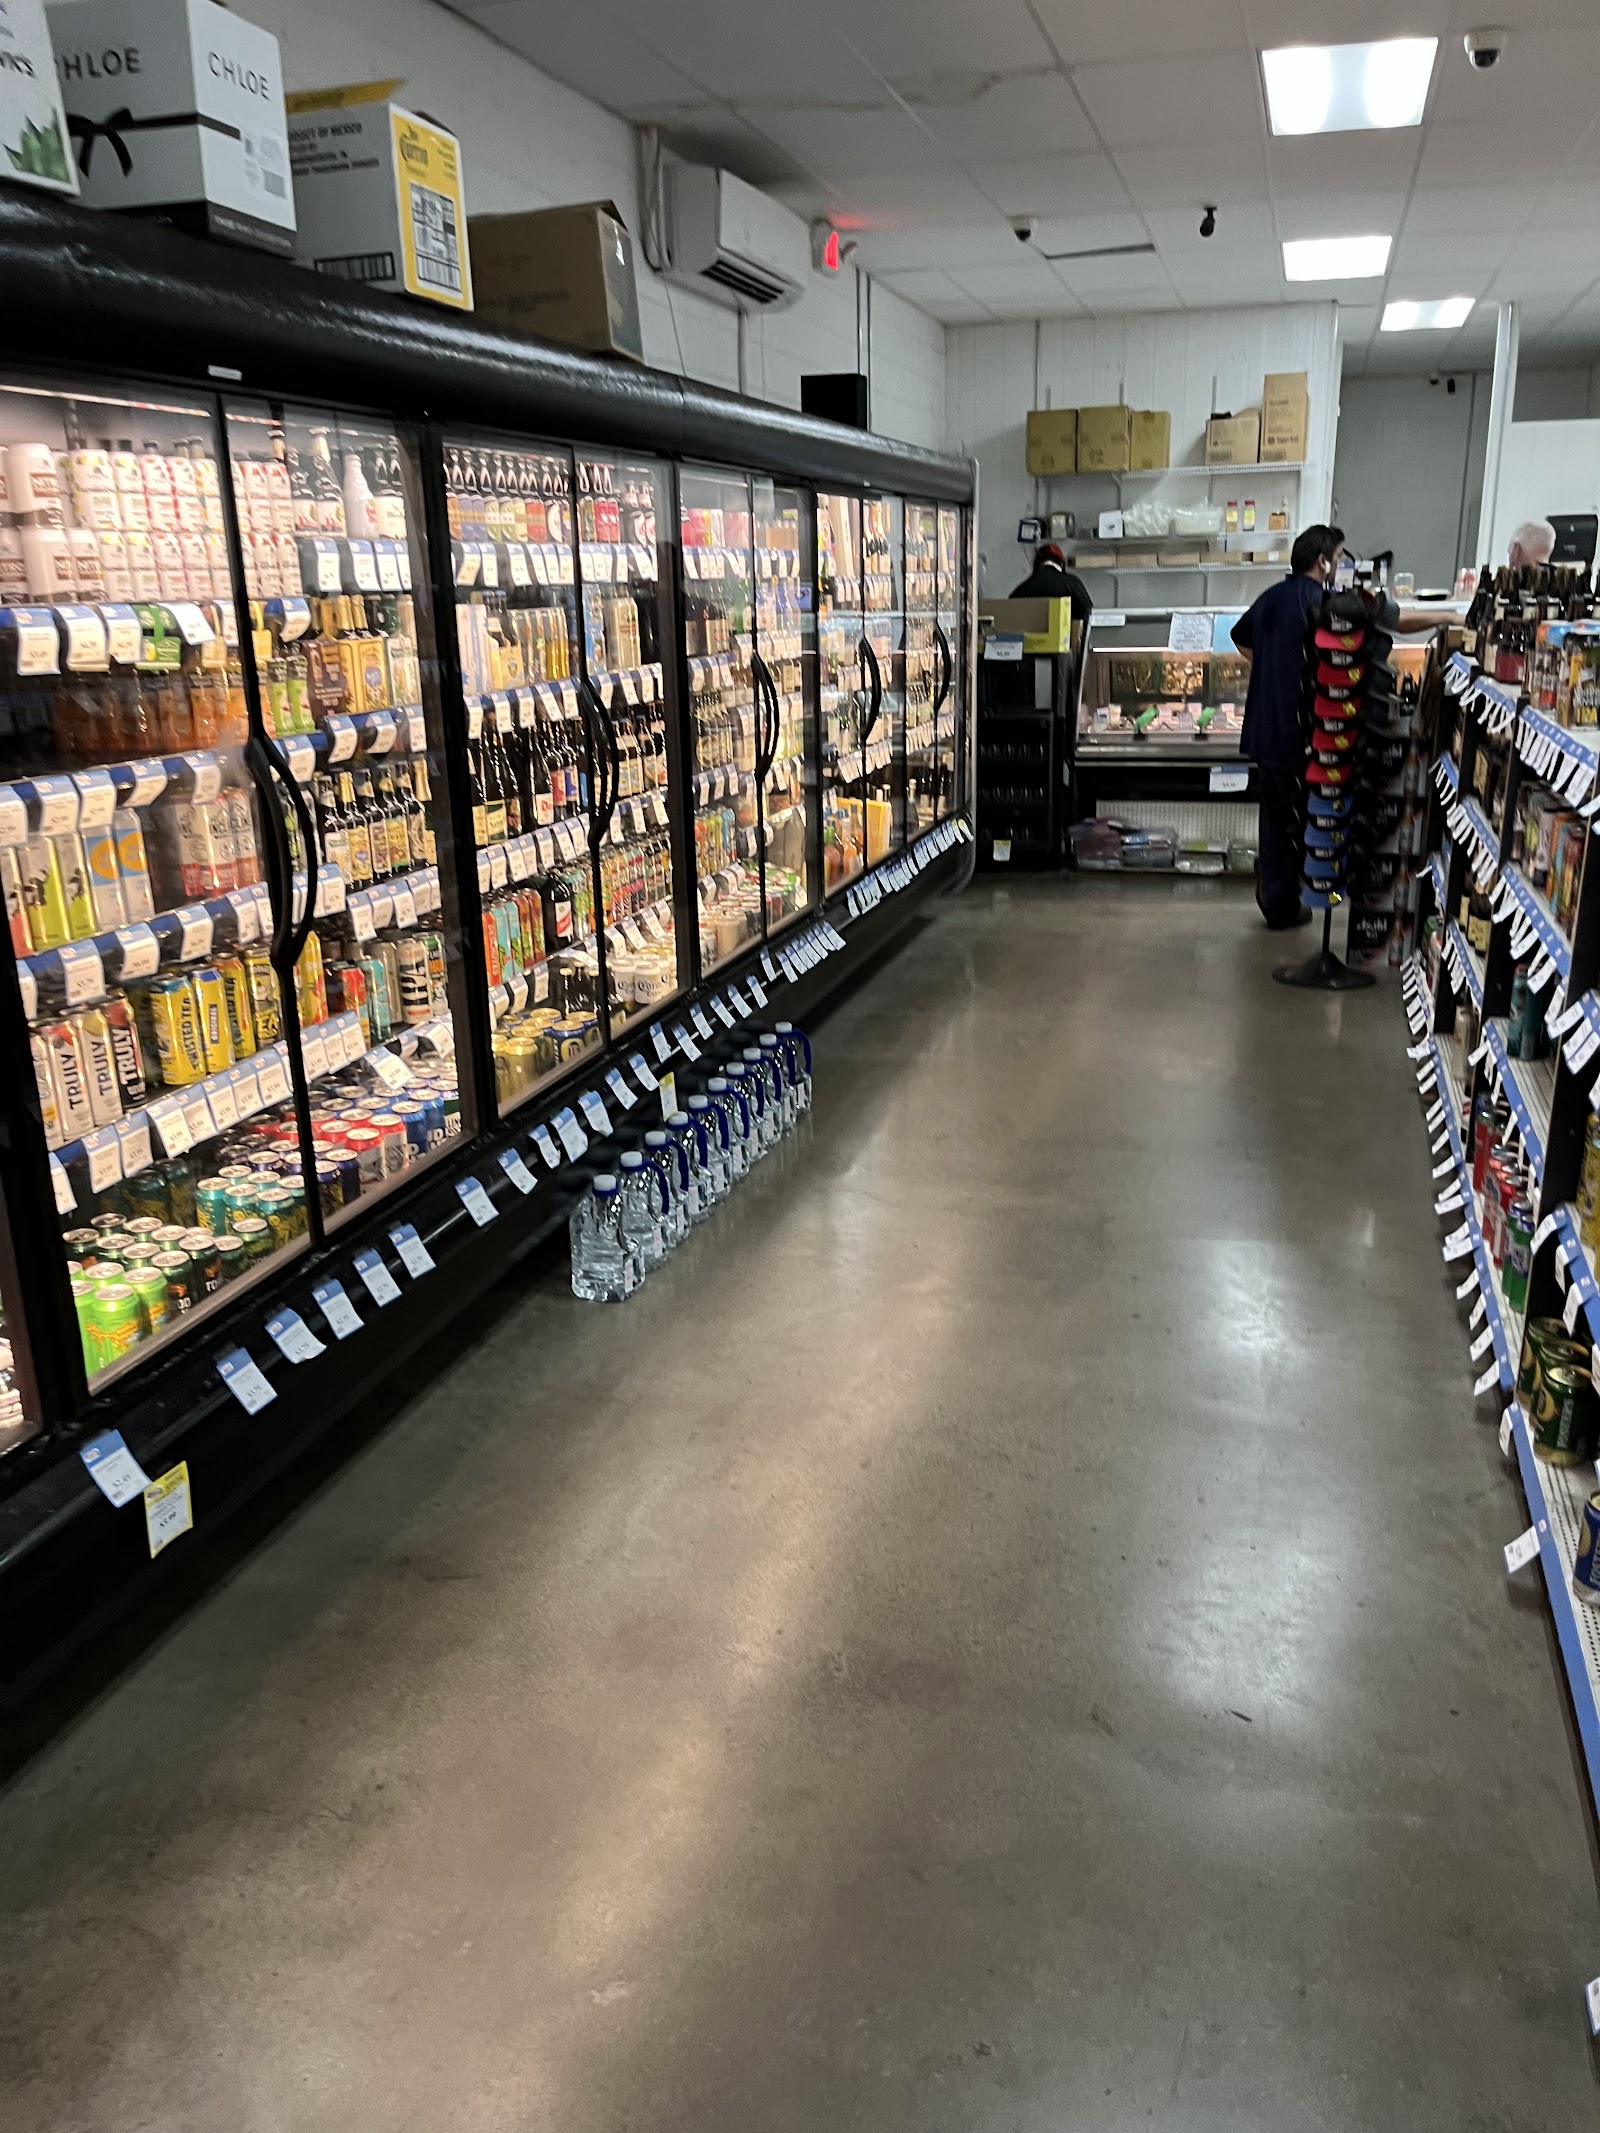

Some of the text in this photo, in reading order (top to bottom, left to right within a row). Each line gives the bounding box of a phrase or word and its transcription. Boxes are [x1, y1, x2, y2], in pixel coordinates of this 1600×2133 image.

[54, 47, 141, 80] HLOE
[207, 50, 270, 102] CHLOE
[113, 1027, 138, 1085] TRULY
[181, 997, 199, 1070] TWISTED TEA
[61, 1053, 83, 1111] TRULY
[91, 1040, 112, 1097] TRULY
